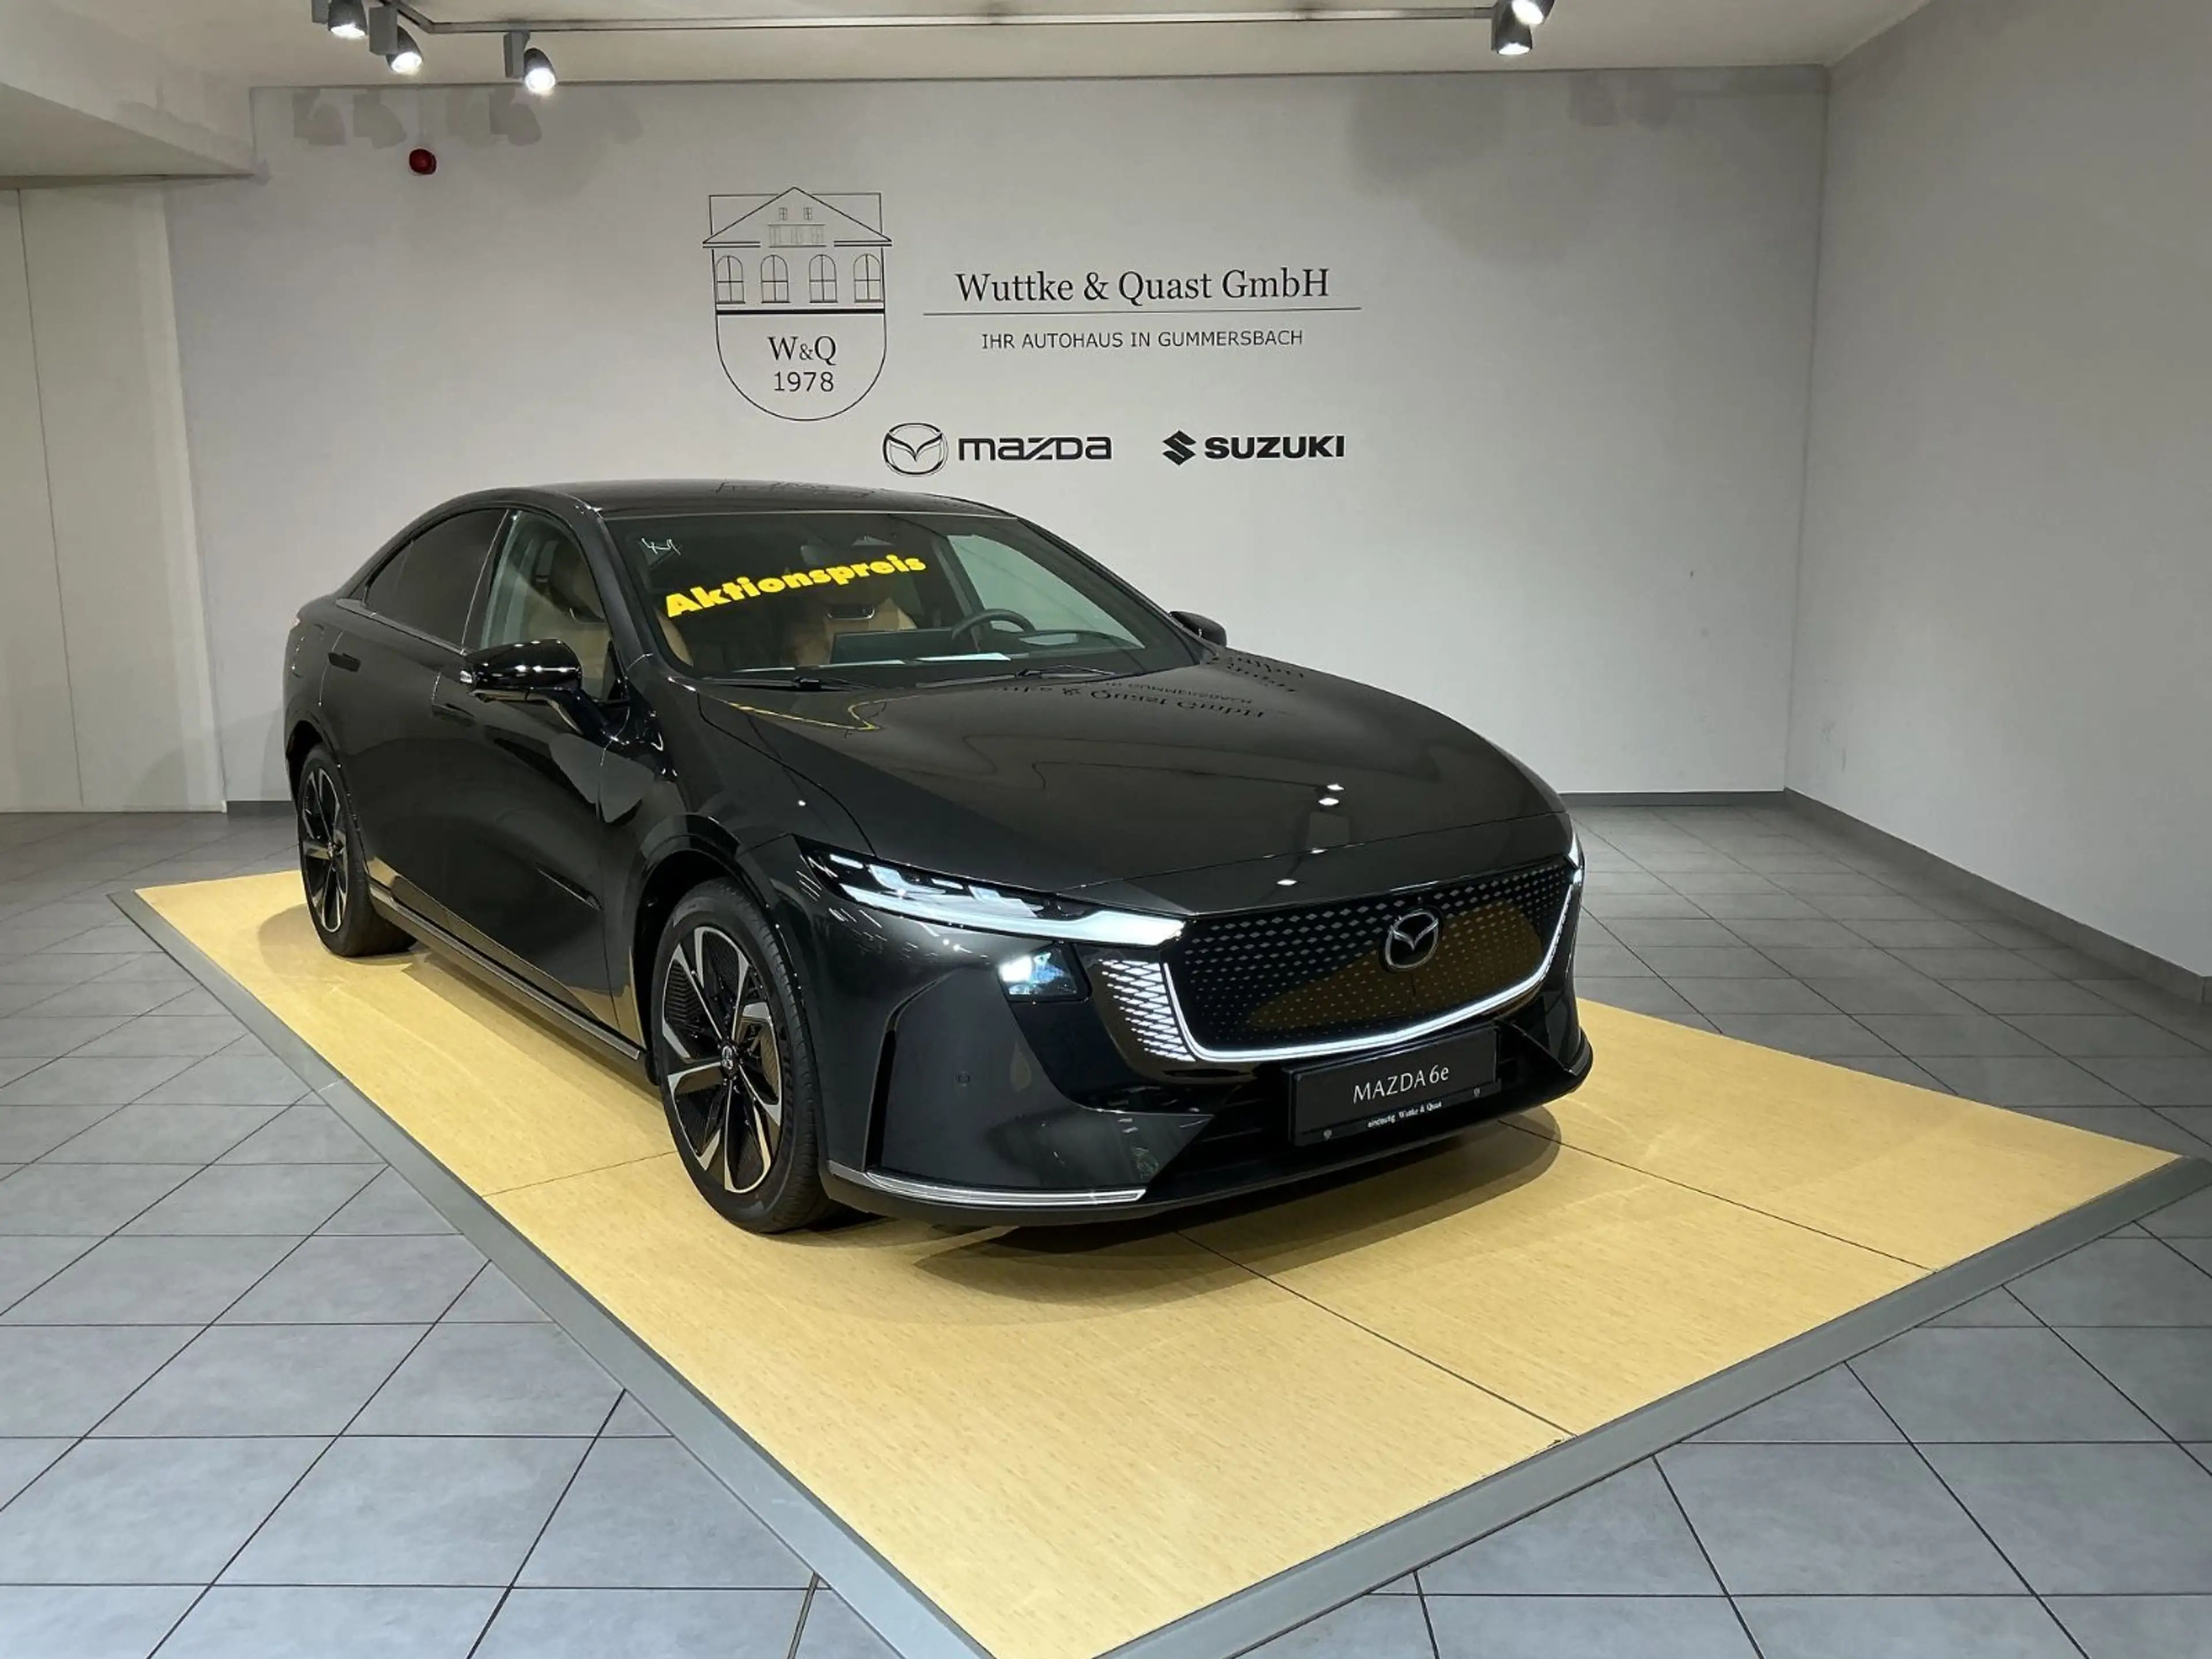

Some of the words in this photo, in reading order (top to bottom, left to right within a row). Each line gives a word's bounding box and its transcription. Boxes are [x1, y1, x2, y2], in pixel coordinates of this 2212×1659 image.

[955, 271, 1074, 303] Wuttke
[1083, 271, 1108, 301] &
[1117, 270, 1213, 306] Quast
[1221, 267, 1330, 300] GmbH
[767, 335, 838, 365] W&Q
[981, 332, 1016, 350] IHR
[1021, 331, 1124, 350] AUTOHAUS
[1131, 331, 1150, 347] IN
[1157, 328, 1304, 348] GUMMERSBACH
[772, 372, 835, 393] 1978
[1204, 434, 1346, 459] SUZUKI
[665, 554, 926, 618] Aktionspreis
[1353, 1069, 1426, 1104] MAZDA
[1429, 1065, 1449, 1084] 6e
